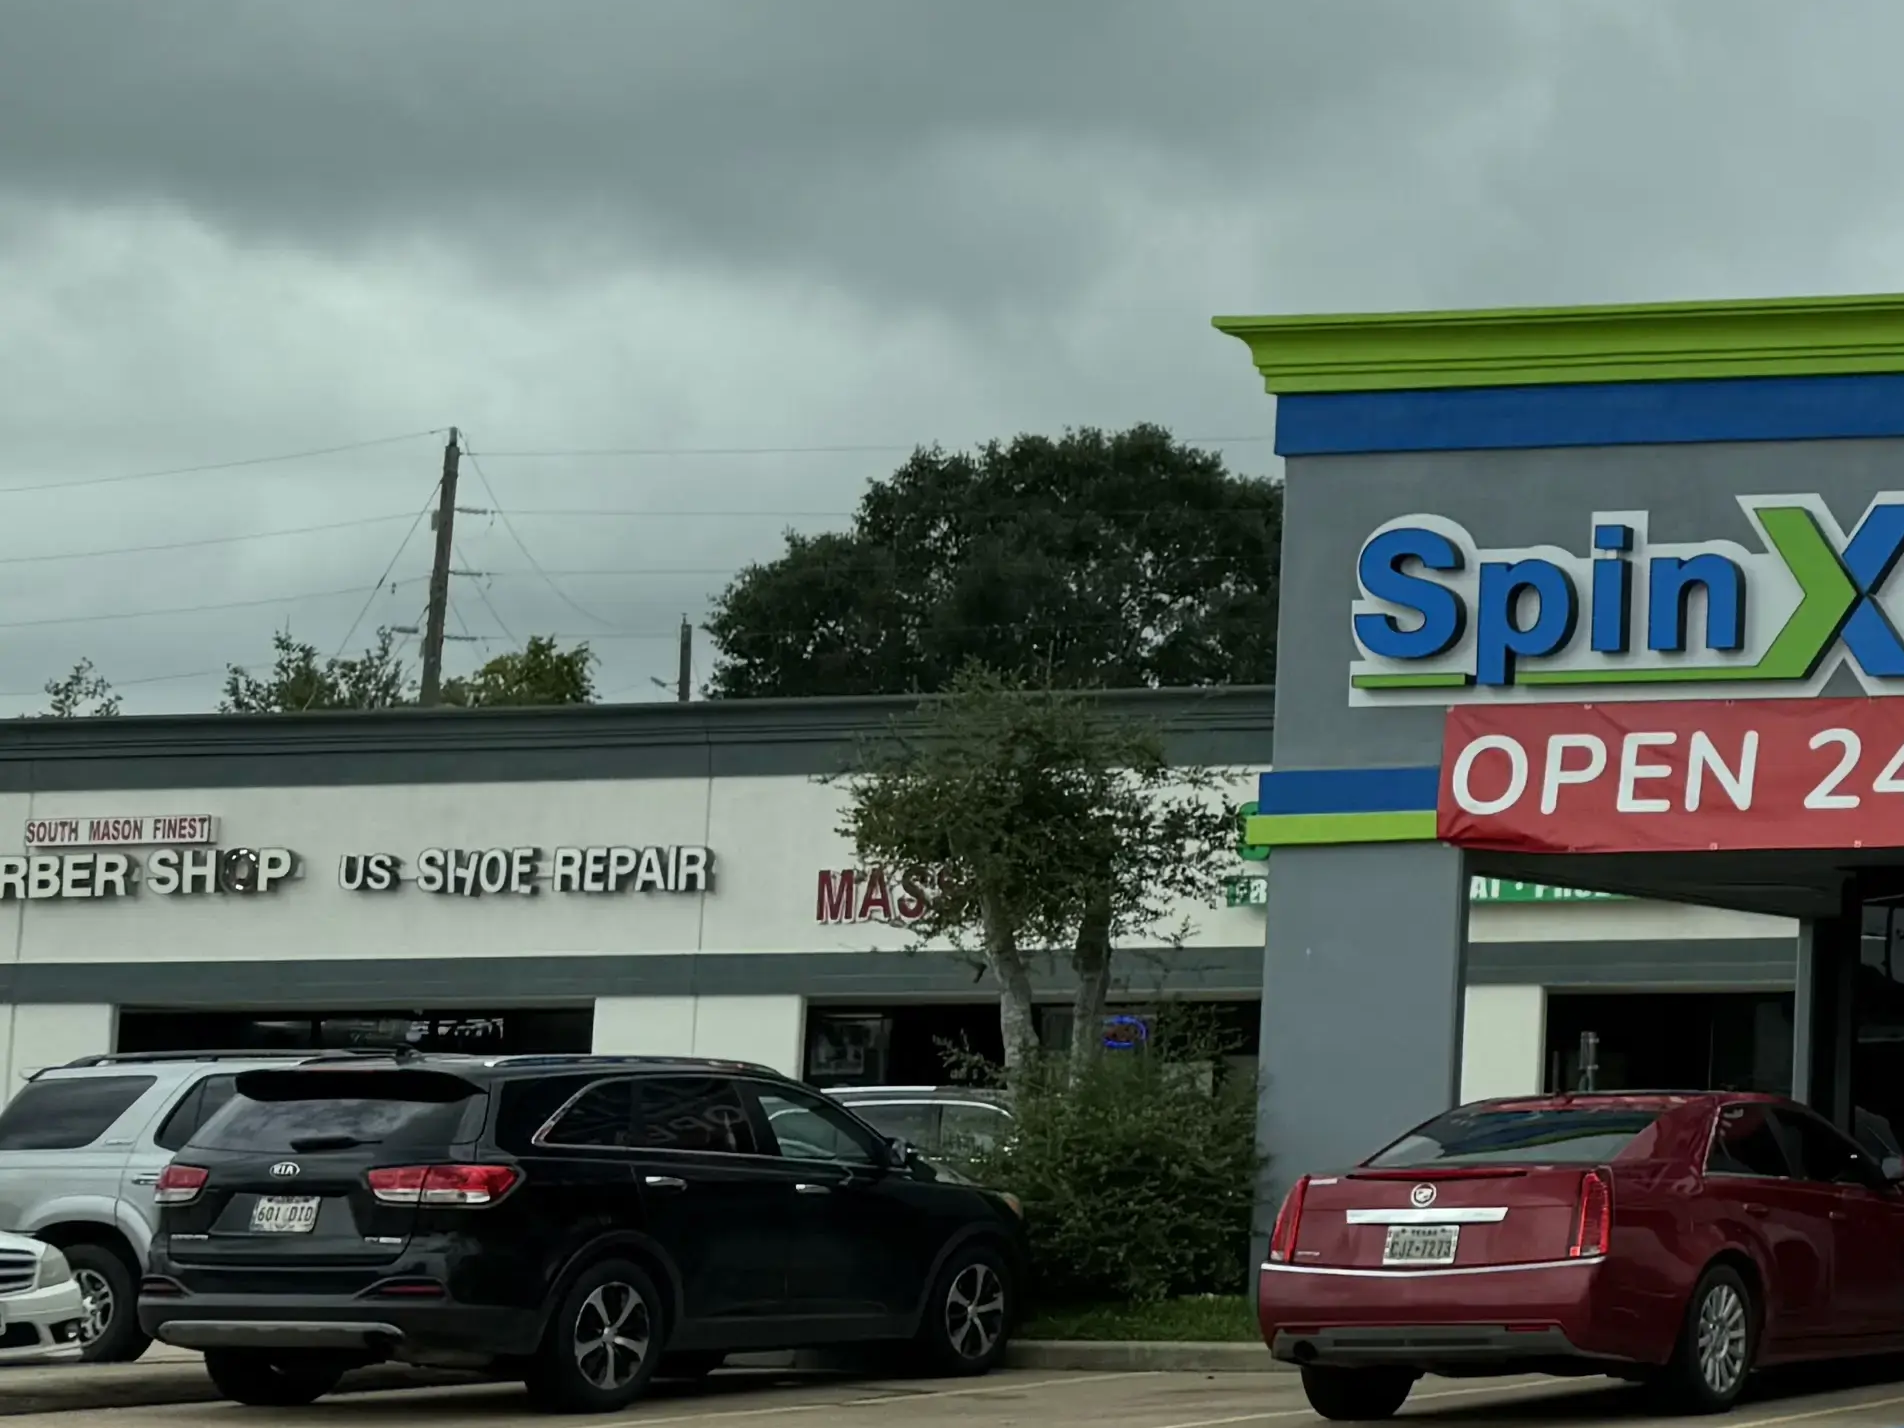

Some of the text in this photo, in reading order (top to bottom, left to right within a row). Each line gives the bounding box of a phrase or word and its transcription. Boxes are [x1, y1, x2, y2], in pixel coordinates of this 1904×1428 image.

[1452, 729, 1760, 816] OPEN
[26, 816, 208, 843] SOUTH MASON FINEST
[147, 847, 292, 896] SHOP
[338, 845, 708, 897] US SHOE REPAIR
